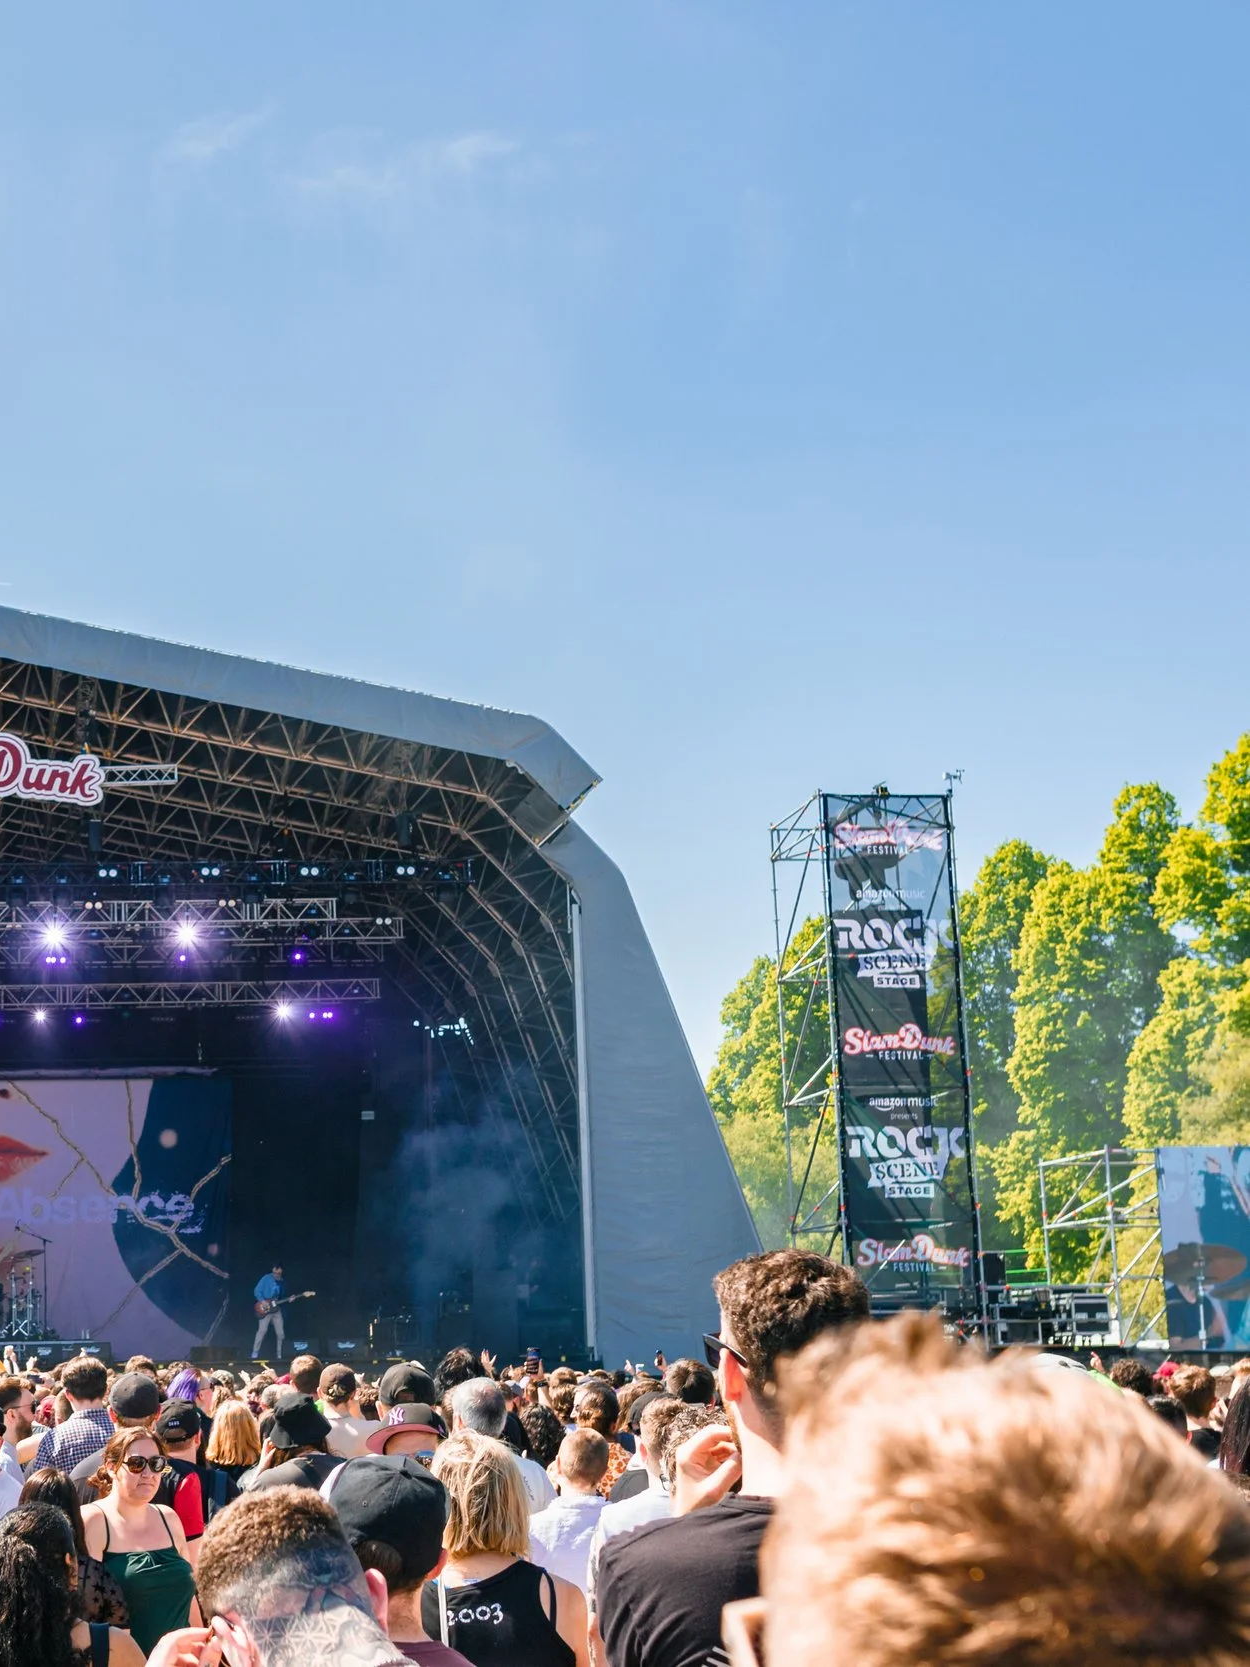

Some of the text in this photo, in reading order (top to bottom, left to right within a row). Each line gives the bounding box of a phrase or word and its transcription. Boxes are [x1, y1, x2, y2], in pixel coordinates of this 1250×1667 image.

[867, 845, 909, 855] FESTIVAL
[876, 977, 917, 986] STAGE
[844, 1026, 900, 1055] Slam
[878, 1051, 924, 1061] FESTIVAL
[869, 1096, 939, 1109] amazon music
[845, 1125, 965, 1158] ROCK
[875, 1161, 940, 1180] SCENE
[888, 1186, 932, 1195] STAGE
[893, 1262, 936, 1273] FESTIVAL
